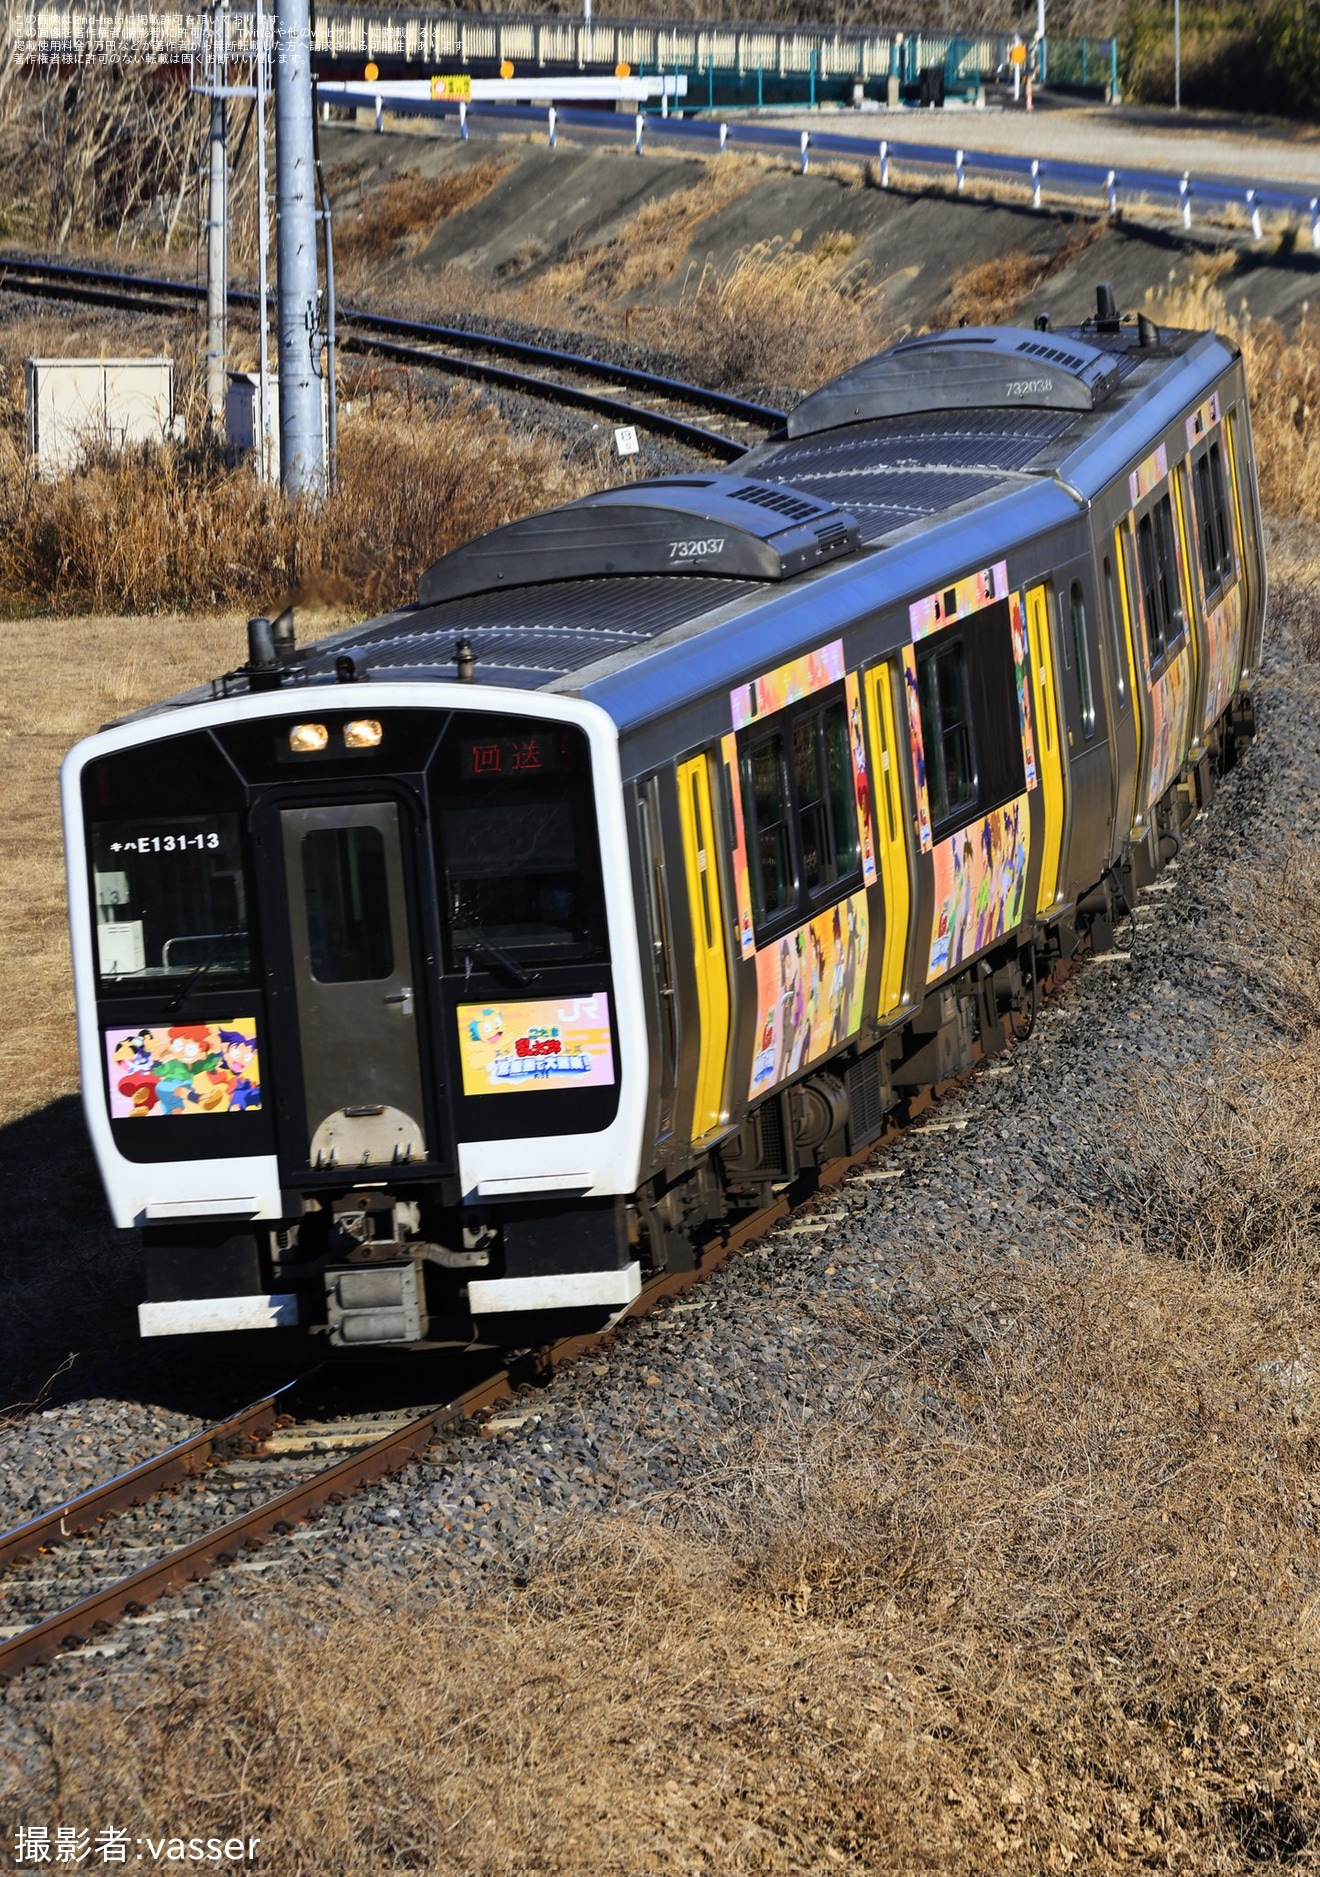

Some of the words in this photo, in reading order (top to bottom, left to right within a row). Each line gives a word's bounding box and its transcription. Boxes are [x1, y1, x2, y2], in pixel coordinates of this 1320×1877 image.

[1005, 379, 1053, 397] 732038
[669, 538, 725, 557] 732037
[472, 739, 542, 773] 回送
[109, 832, 220, 853] キハE131-13
[558, 998, 601, 1022] JR
